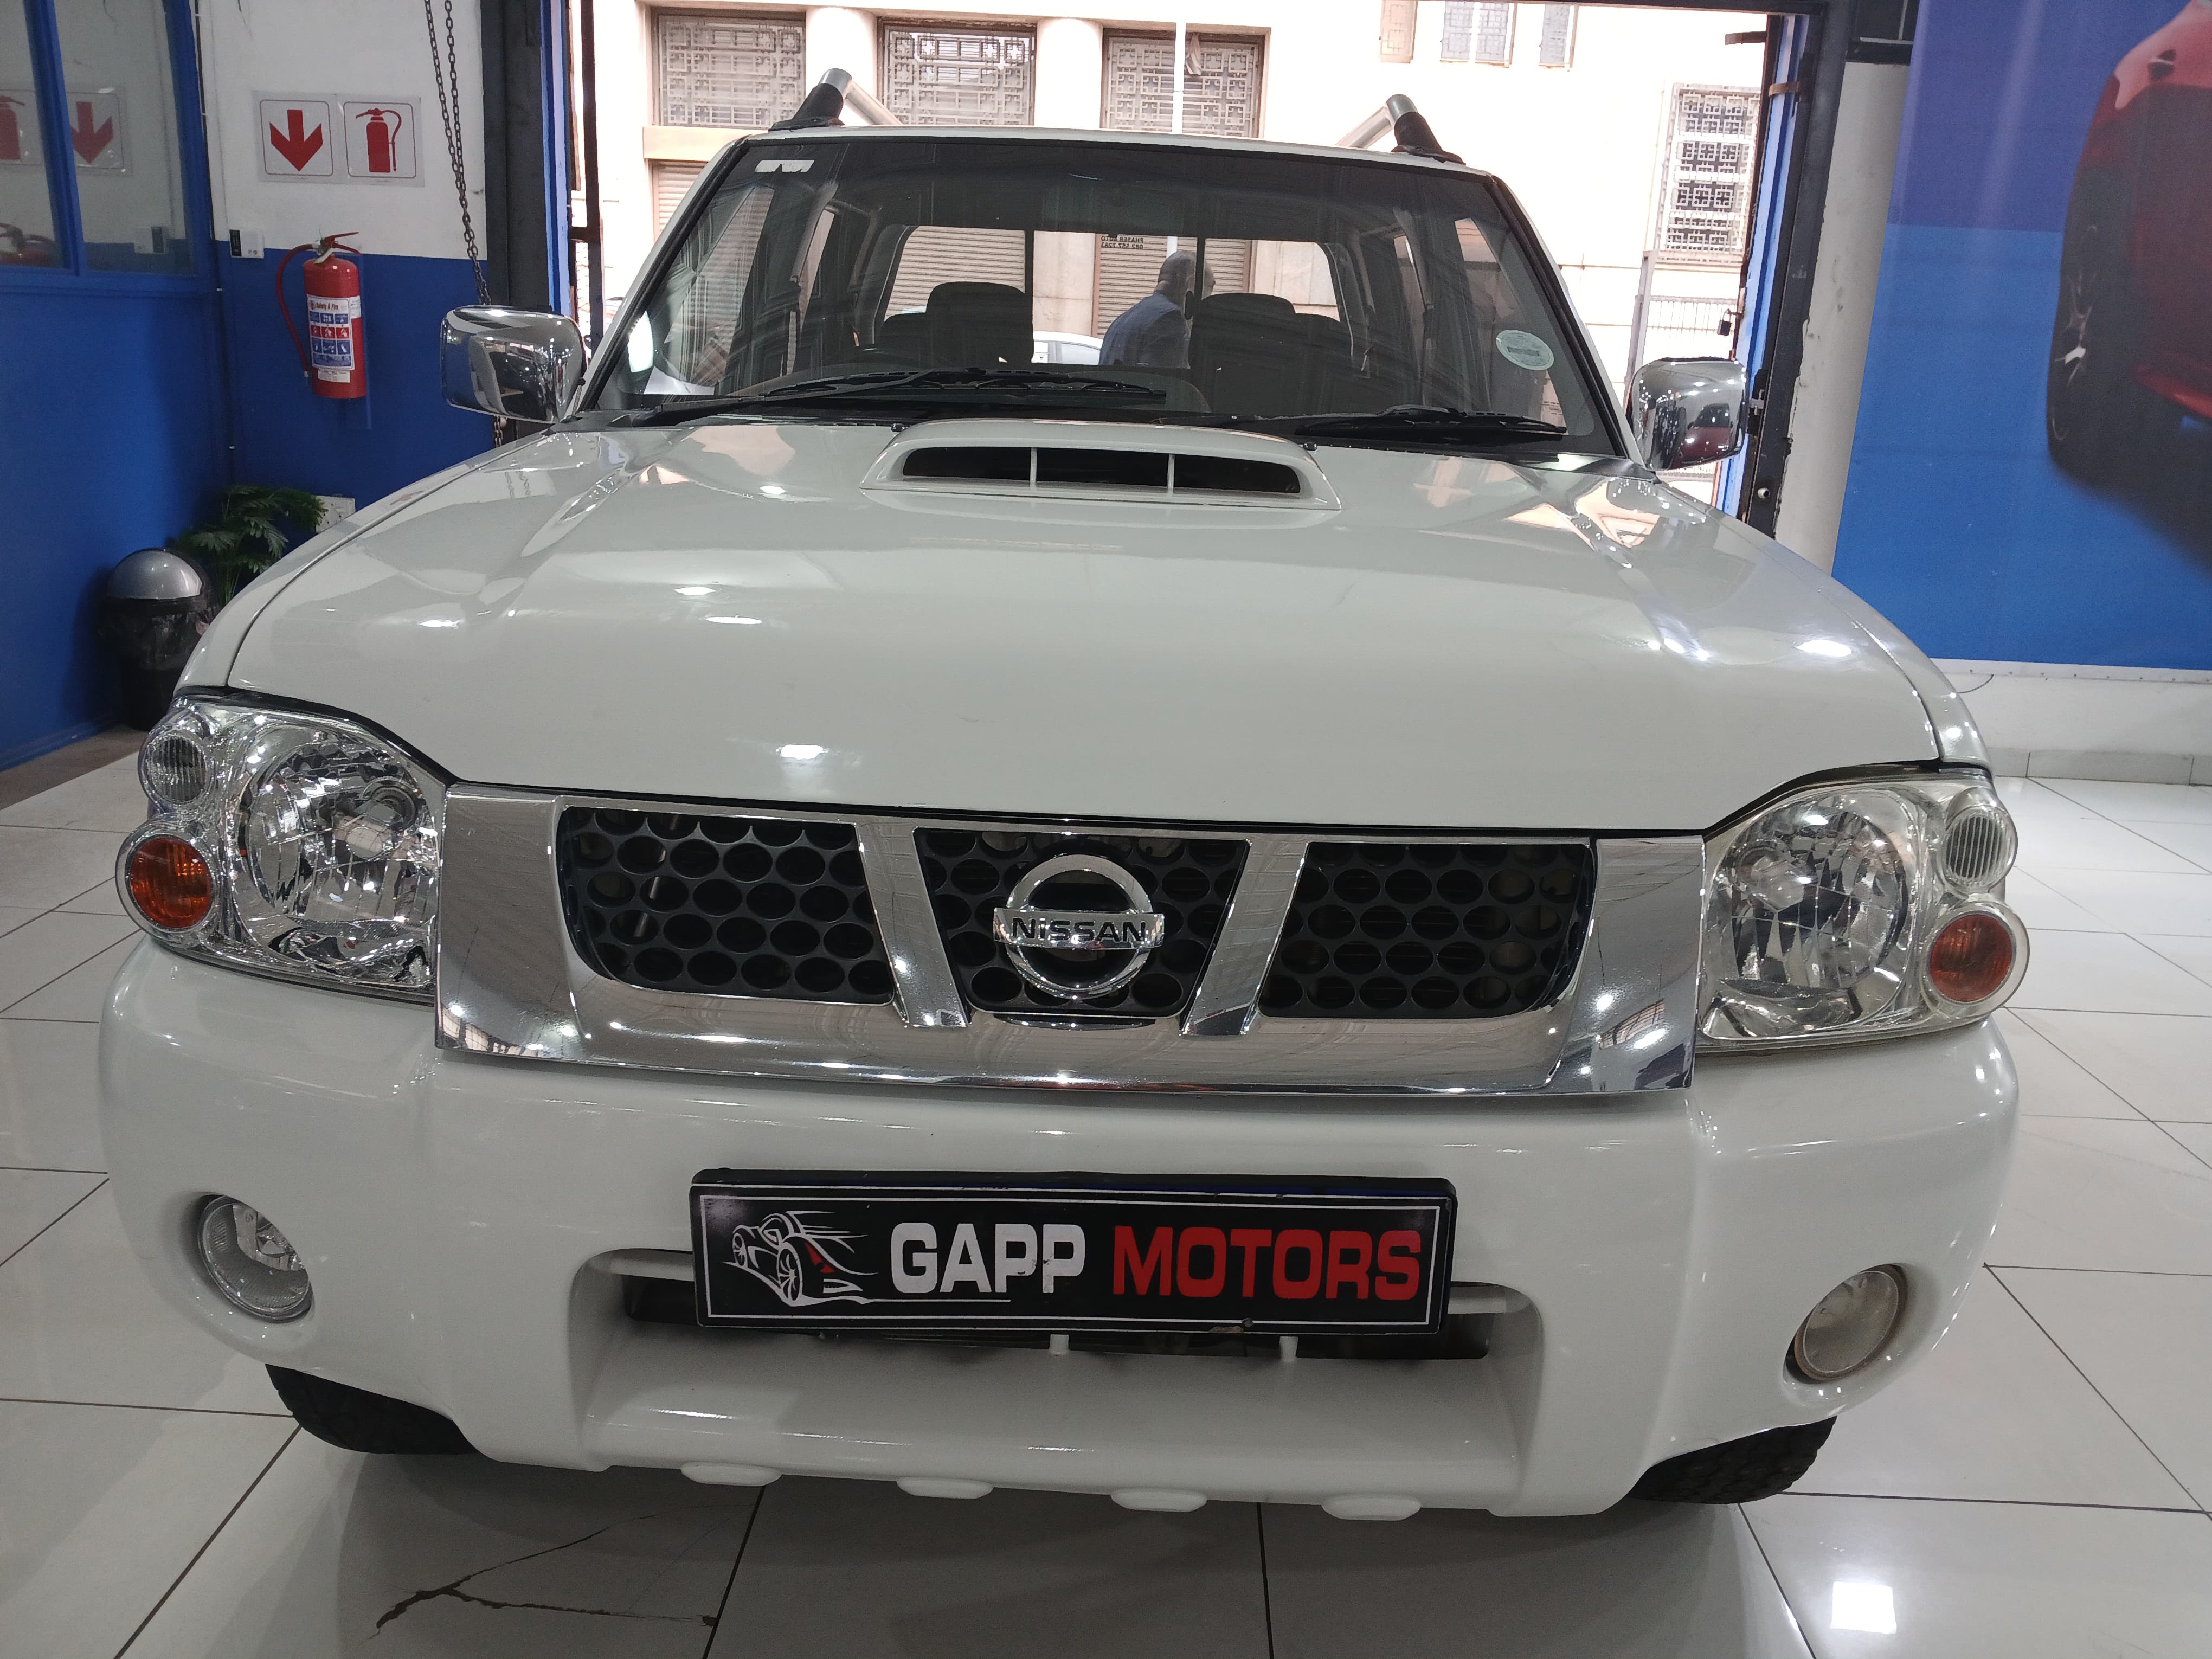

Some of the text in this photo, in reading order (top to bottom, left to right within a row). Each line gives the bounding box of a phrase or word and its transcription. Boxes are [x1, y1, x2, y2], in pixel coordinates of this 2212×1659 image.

[1012, 917, 1146, 942] NISSAN
[891, 1222, 1422, 1301] GAPP MOTORS
